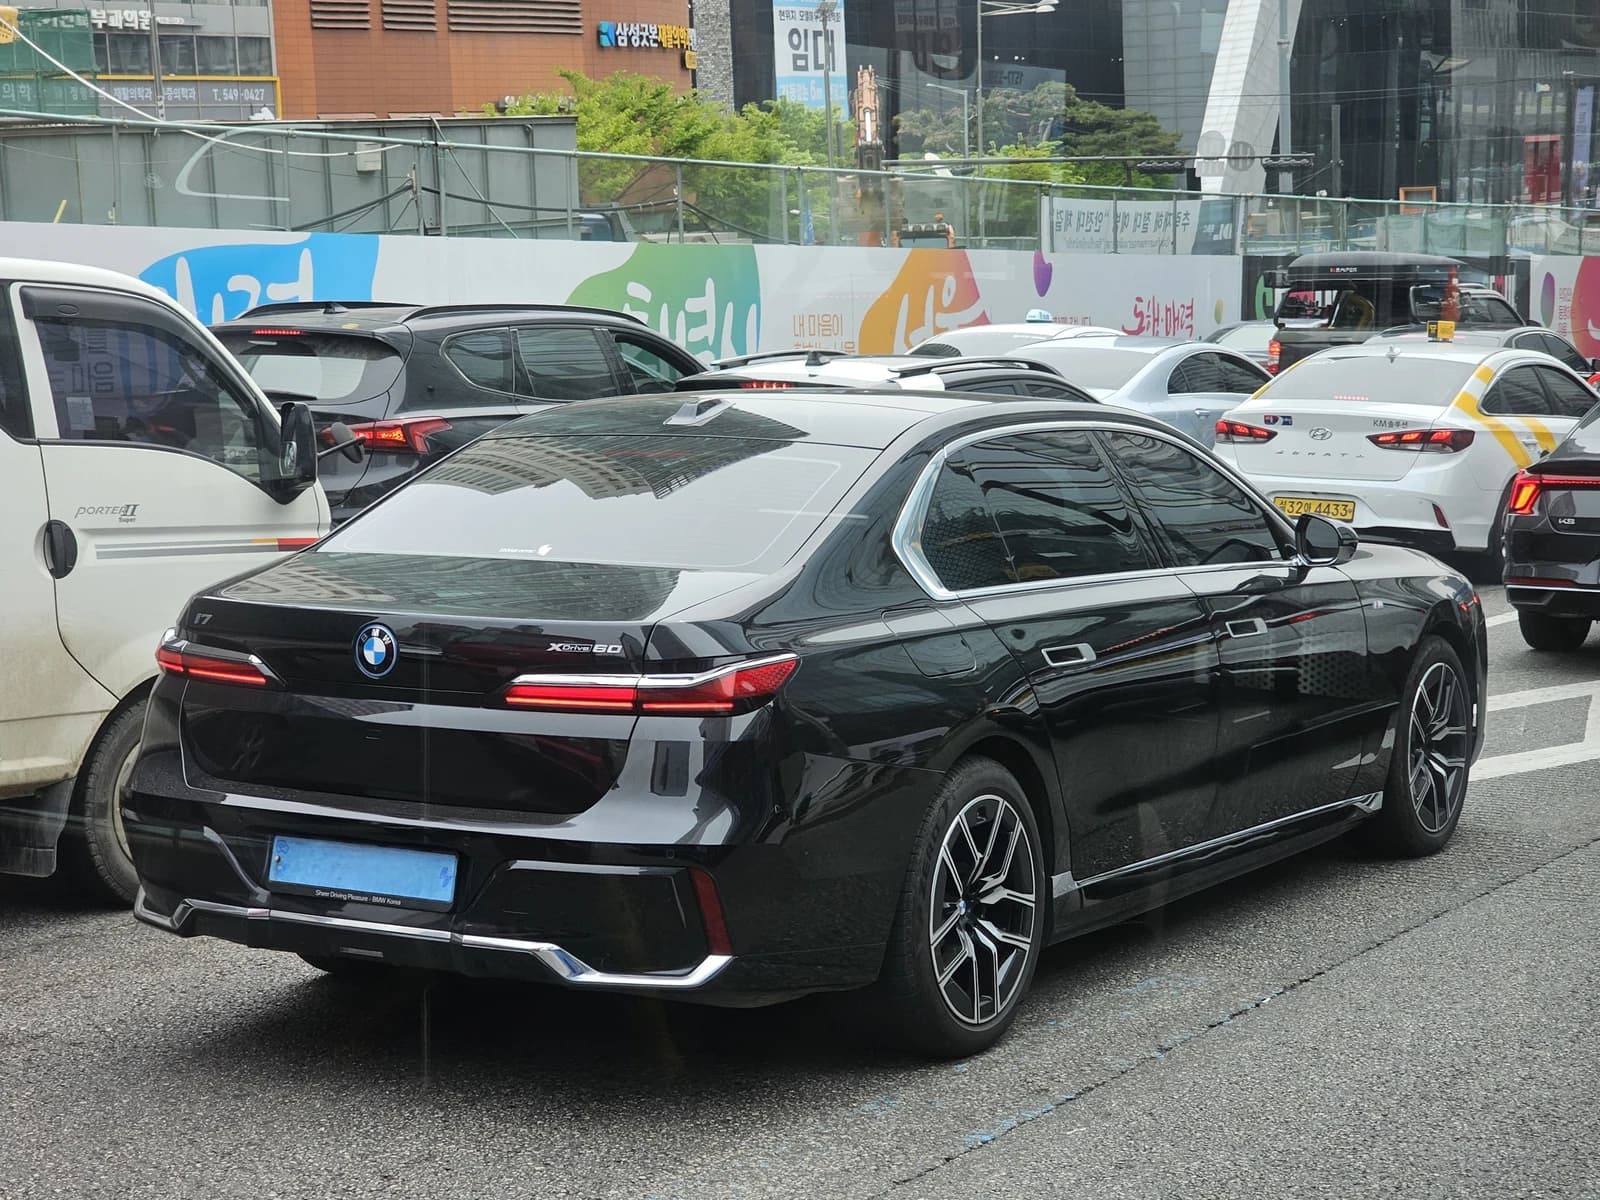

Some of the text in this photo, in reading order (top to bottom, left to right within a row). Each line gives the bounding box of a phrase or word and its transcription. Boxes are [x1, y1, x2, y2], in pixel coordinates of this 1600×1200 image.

[787, 27, 836, 72] 임대
[1314, 502, 1349, 517] 4433
[360, 628, 392, 645] BMW
[592, 643, 623, 654] 60
[330, 890, 348, 901] Driving
[347, 892, 369, 902] Pleasure
[371, 895, 387, 904] BMW
